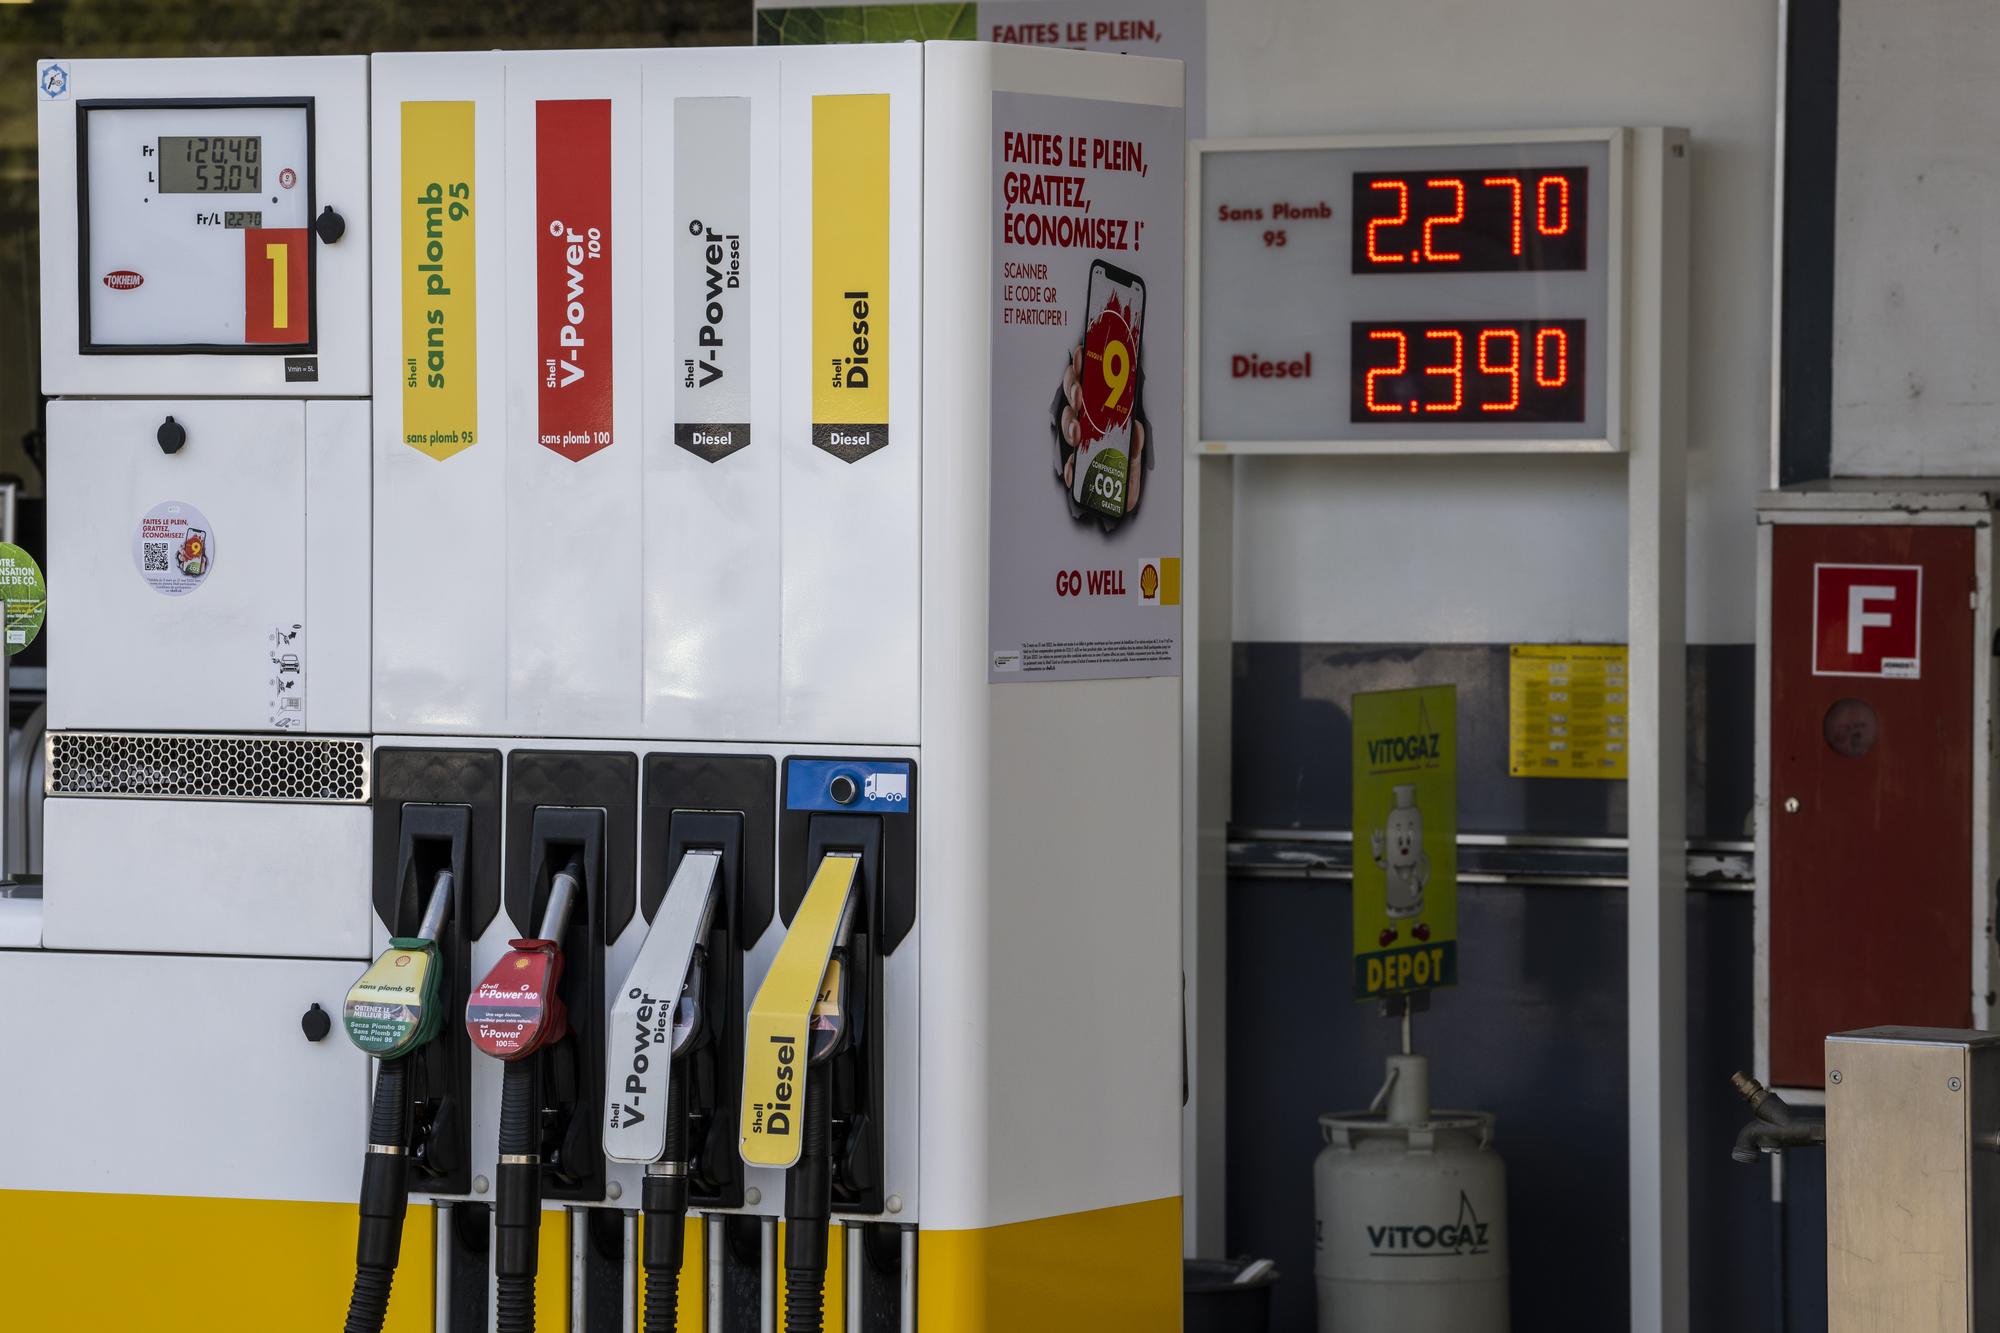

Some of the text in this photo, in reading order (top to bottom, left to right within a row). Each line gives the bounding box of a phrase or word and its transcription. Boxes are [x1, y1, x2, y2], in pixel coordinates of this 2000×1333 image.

[992, 20, 1162, 44] FAITES LE PLEIN,
[143, 146, 154, 156] Fr
[187, 138, 258, 164] 120,40
[1004, 132, 1148, 178] FAITES LE PLEIN,
[148, 172, 154, 182] L
[196, 165, 258, 192] 53,04
[448, 182, 469, 222] 95
[1004, 172, 1091, 214] GRATTEZ,
[197, 212, 220, 226] Fr/L
[1218, 202, 1332, 221] Sans Plomb
[1004, 203, 1128, 250] ÉCONOMISEZ
[1263, 230, 1287, 247] 95
[588, 228, 600, 259] 100
[726, 235, 739, 288] Diesel
[1004, 262, 1047, 280] SCANNER
[106, 274, 140, 288] TOKHEIM
[266, 244, 288, 328] 1
[418, 183, 450, 389] sans plomb
[1004, 285, 1056, 303] LE CODE QR
[560, 228, 584, 388] V-Power
[699, 228, 723, 388] V-Power
[1004, 308, 1013, 323] ET
[1016, 309, 1062, 326] PARTICIPER
[844, 292, 869, 388] Diesel
[408, 358, 416, 388] Shell
[547, 359, 556, 388] Shell
[685, 360, 694, 388] Shell
[832, 359, 841, 388] Shell
[1103, 340, 1129, 408] 9
[1231, 352, 1312, 379] Diesel
[406, 431, 473, 446] sans plomb 95
[541, 432, 610, 447] sans plomb 100
[692, 432, 732, 445] Diesel
[830, 432, 870, 445] Diesel
[1095, 473, 1122, 502] CO2
[192, 542, 201, 555] 9
[0, 558, 15, 567] TRE
[12, 576, 22, 585] DE
[1056, 570, 1126, 596] GO WELL
[1848, 585, 1896, 654] F
[1367, 949, 1444, 992] DEPOT
[480, 990, 522, 998] V-Power
[480, 1030, 520, 1038] V-Power
[654, 1000, 671, 1043] Diesel
[623, 993, 656, 1129] V-Power
[767, 1036, 795, 1135] Diesel
[610, 1103, 620, 1129] Shell
[753, 1104, 763, 1134] Shell
